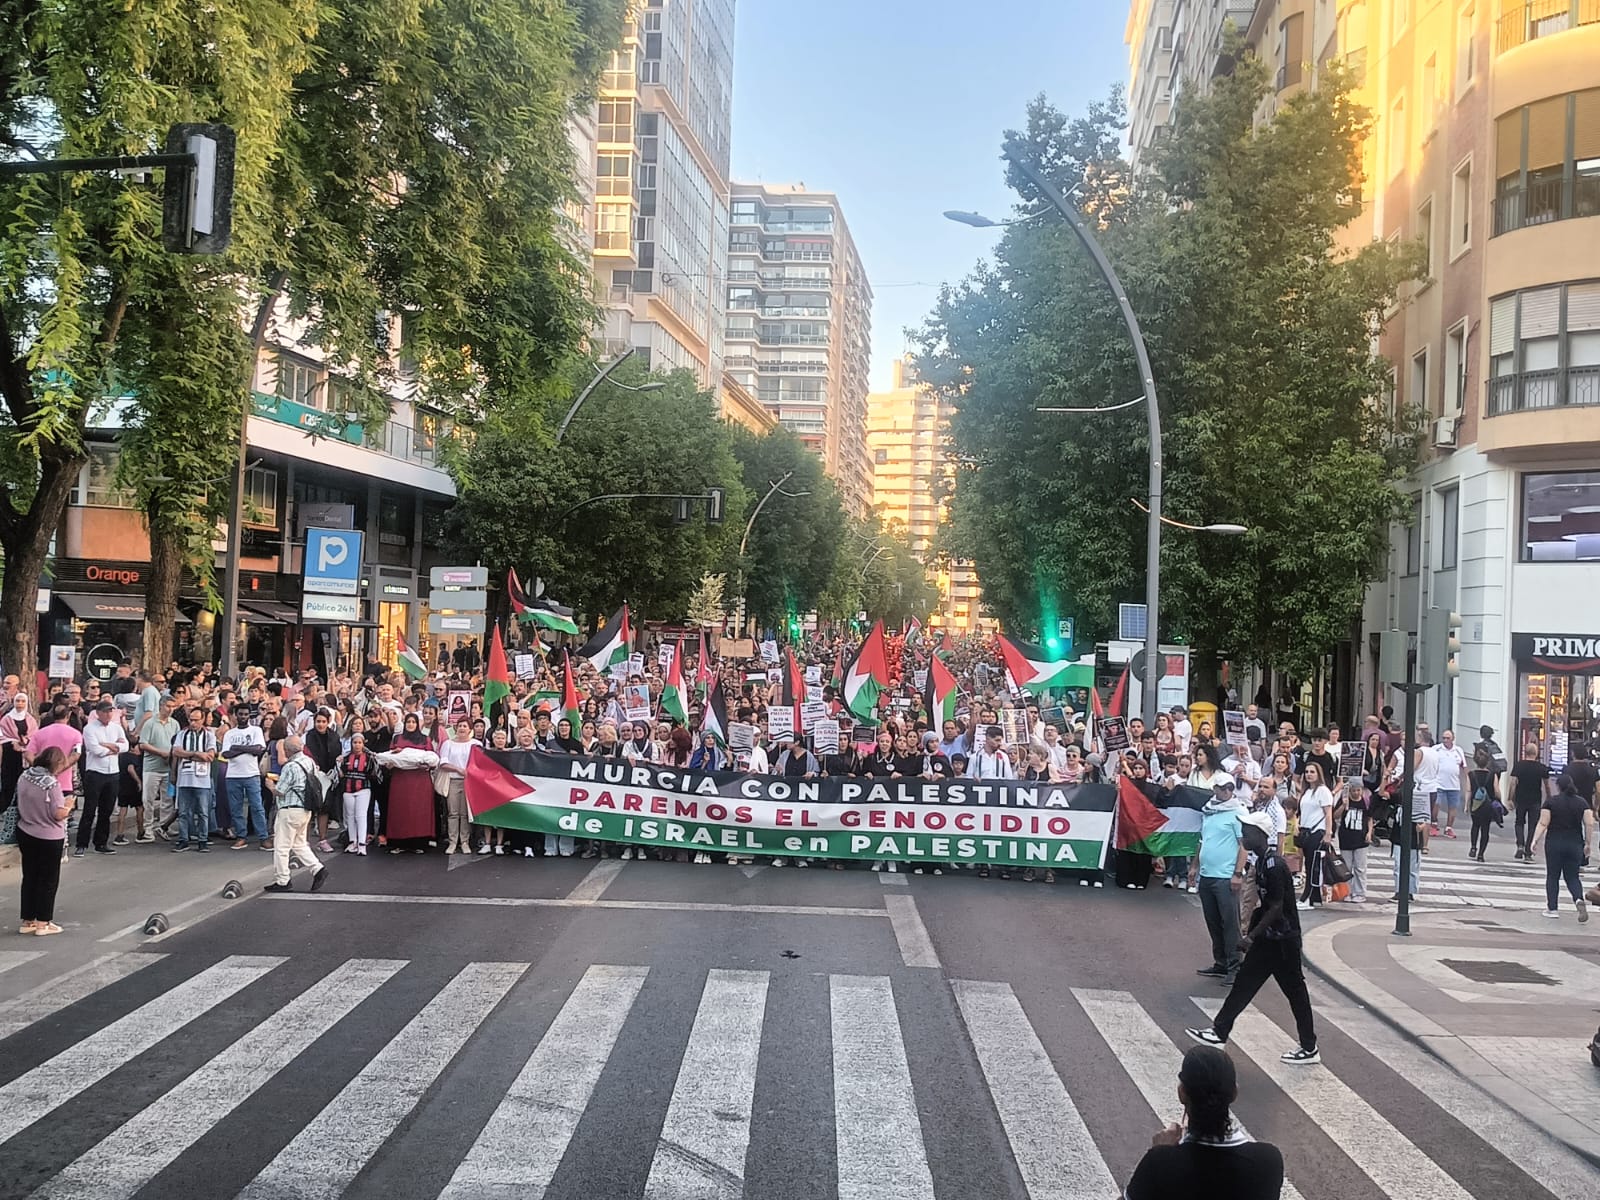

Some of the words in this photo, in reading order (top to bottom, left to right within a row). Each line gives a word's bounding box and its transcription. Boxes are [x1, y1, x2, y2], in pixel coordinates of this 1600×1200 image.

[86, 566, 140, 584] Orange
[95, 604, 146, 612] Orang
[306, 602, 336, 612] Público
[337, 605, 347, 613] 24
[349, 605, 355, 613] h
[570, 760, 720, 795] MURCIA
[741, 779, 820, 801] CON
[842, 783, 1070, 808] PALESTINA
[569, 787, 752, 823] PAREMOS
[775, 808, 818, 827] EL
[839, 810, 1071, 835] GENOCIDIO
[558, 812, 603, 833] de
[624, 818, 763, 848] ISRAEL
[784, 835, 829, 852] en
[851, 834, 1079, 862] PALESTINA
